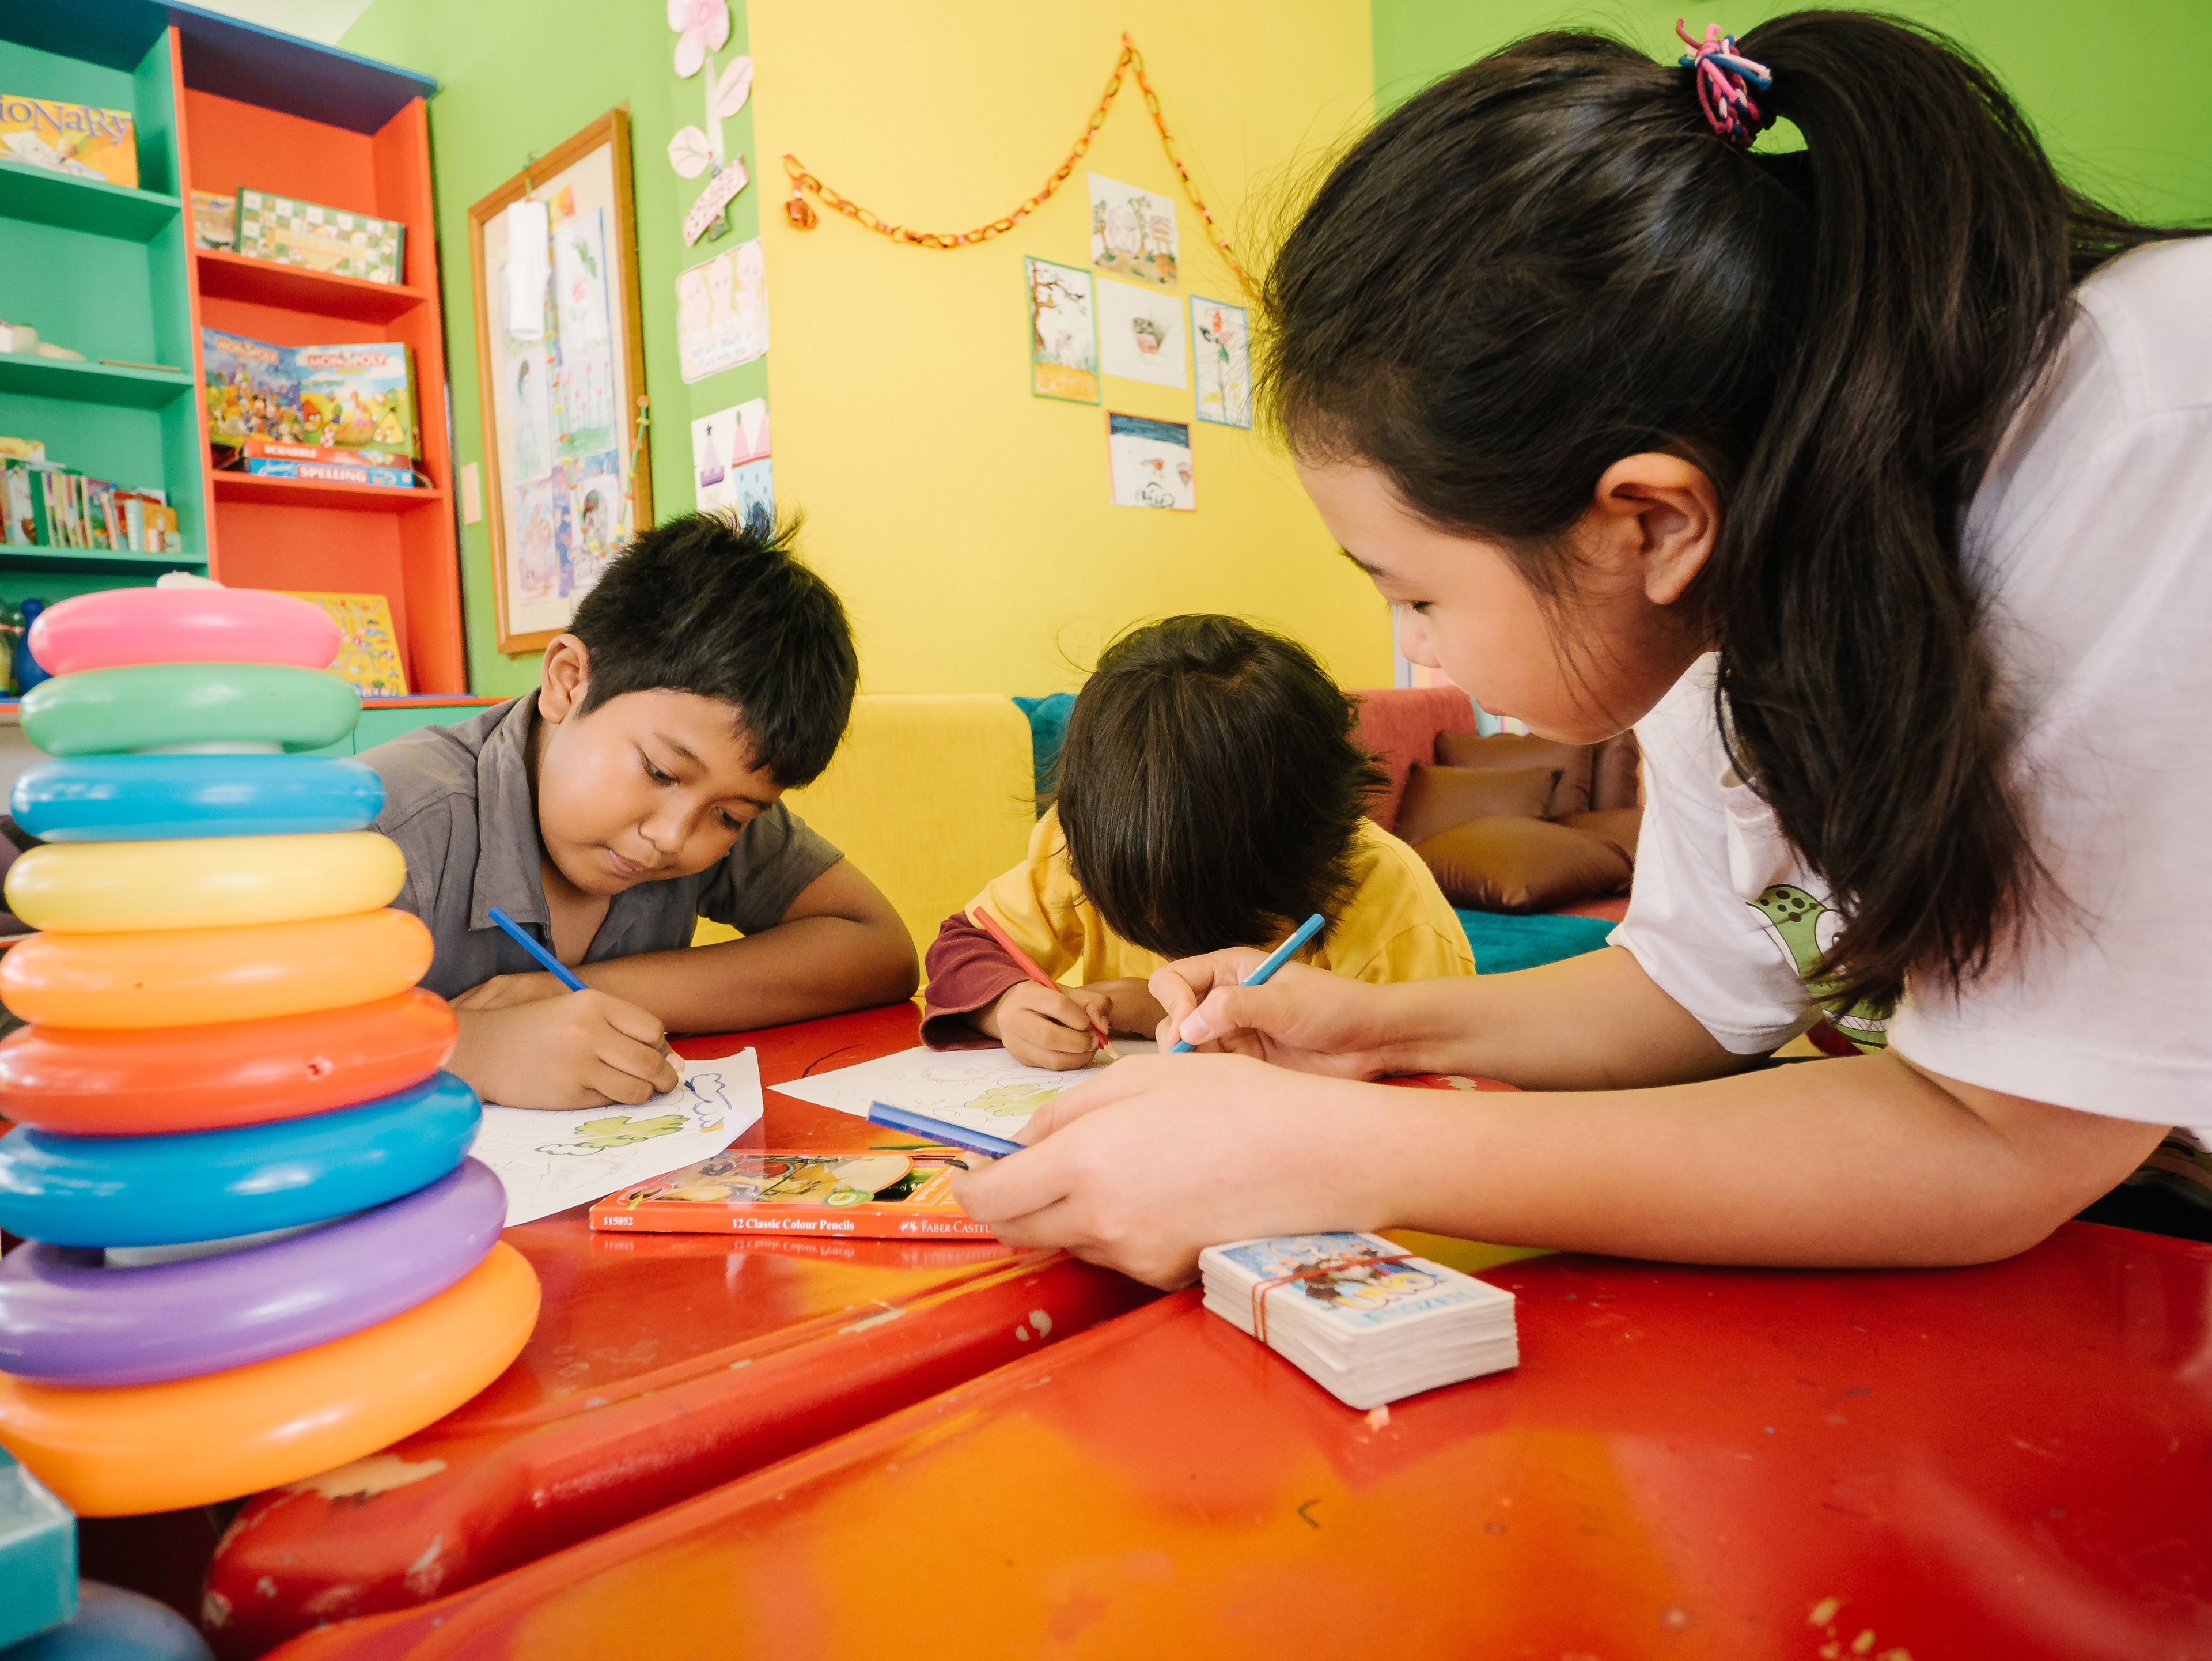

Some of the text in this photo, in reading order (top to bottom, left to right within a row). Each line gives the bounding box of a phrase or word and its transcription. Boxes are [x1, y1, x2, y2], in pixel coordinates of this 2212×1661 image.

[264, 444, 316, 459] SCRABBLE
[299, 466, 367, 483] SPELLING
[732, 1218, 744, 1228] 12
[745, 1218, 780, 1229] Classic
[782, 1219, 817, 1230] Colour
[819, 1219, 855, 1231] Pencils
